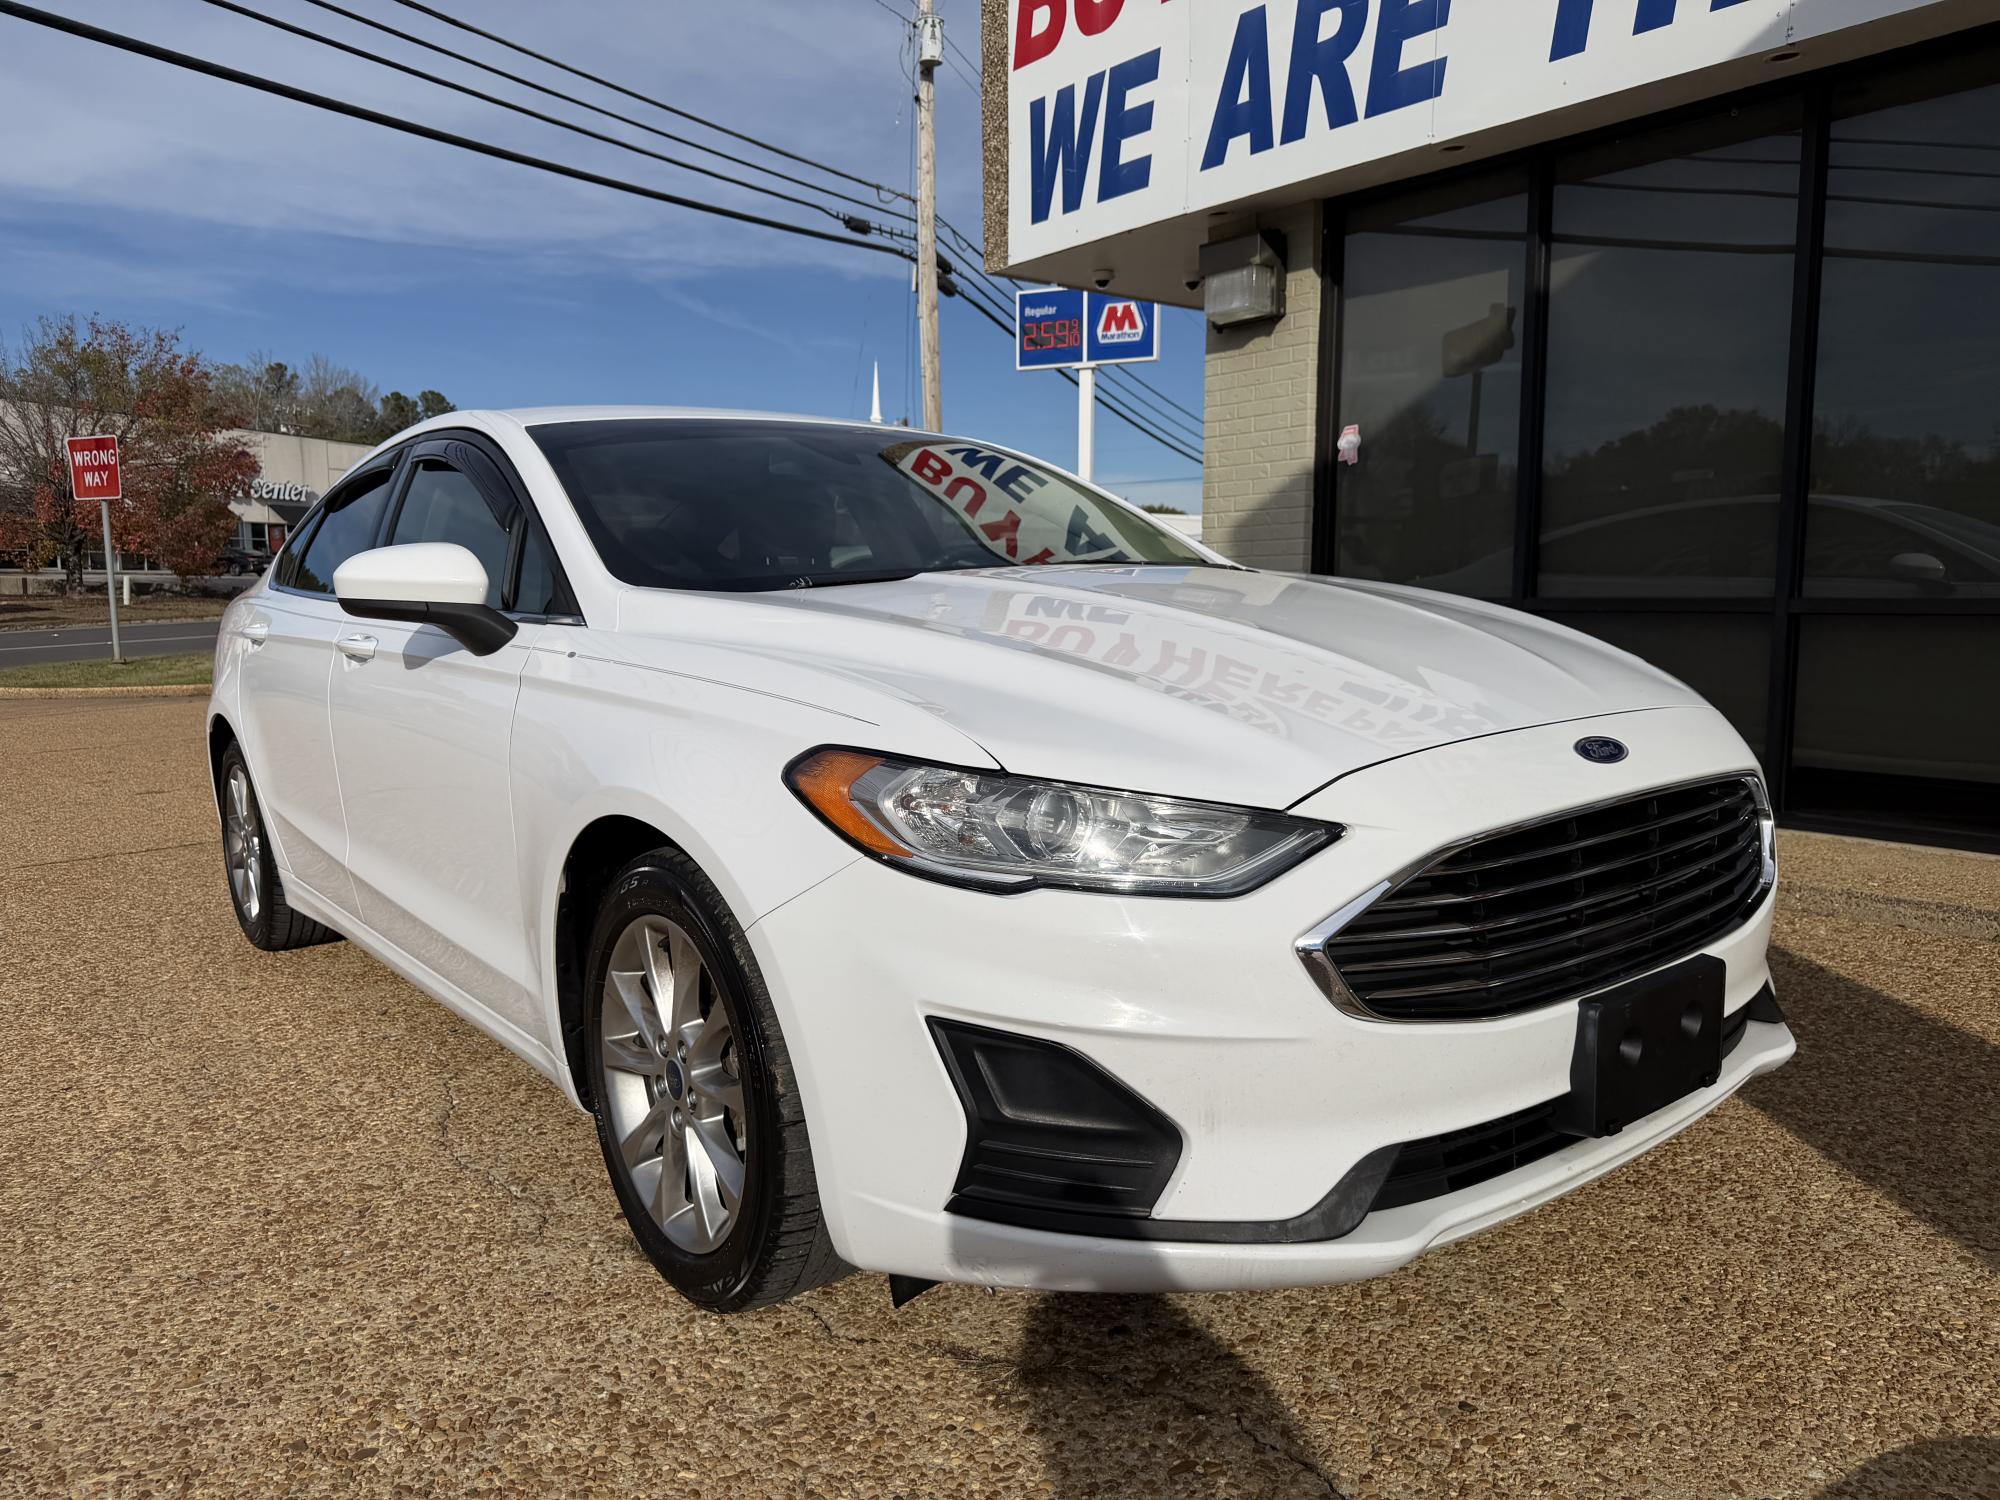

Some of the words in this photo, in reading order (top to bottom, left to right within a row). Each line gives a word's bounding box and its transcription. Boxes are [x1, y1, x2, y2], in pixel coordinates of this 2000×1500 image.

[1030, 47, 1162, 225] WE
[1200, 0, 1454, 172] ARE
[1024, 305, 1057, 318] Regular
[1101, 331, 1140, 341] Marathon
[73, 448, 116, 466] WRONG
[83, 470, 109, 487] WAY
[1585, 741, 1619, 758] Ford
